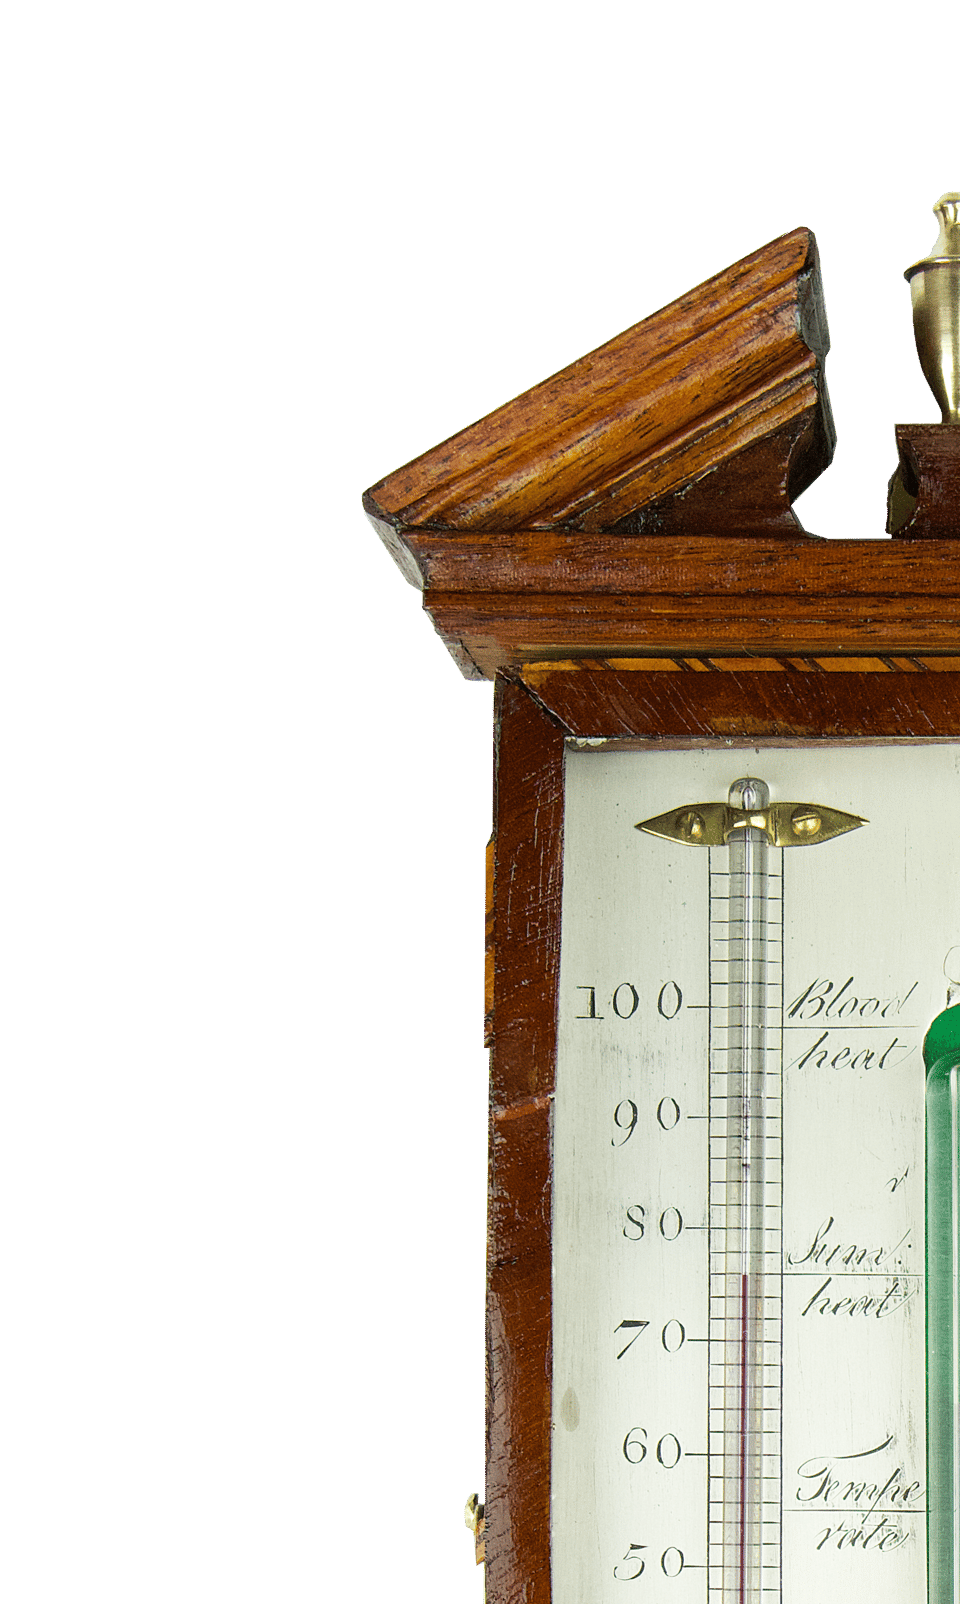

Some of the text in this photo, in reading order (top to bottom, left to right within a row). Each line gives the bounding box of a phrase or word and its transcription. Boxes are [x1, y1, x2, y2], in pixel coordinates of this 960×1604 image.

[576, 980, 683, 1020] 100
[785, 976, 918, 1020] Blood
[785, 1031, 914, 1072] heat
[611, 1096, 681, 1146] 90
[622, 1204, 683, 1242] 80
[801, 1276, 917, 1320] heat
[613, 1318, 686, 1360] 70
[622, 1427, 682, 1470] 60
[796, 1435, 926, 1525] Tempe
[814, 1517, 911, 1553] rate
[612, 1544, 684, 1581] 50
